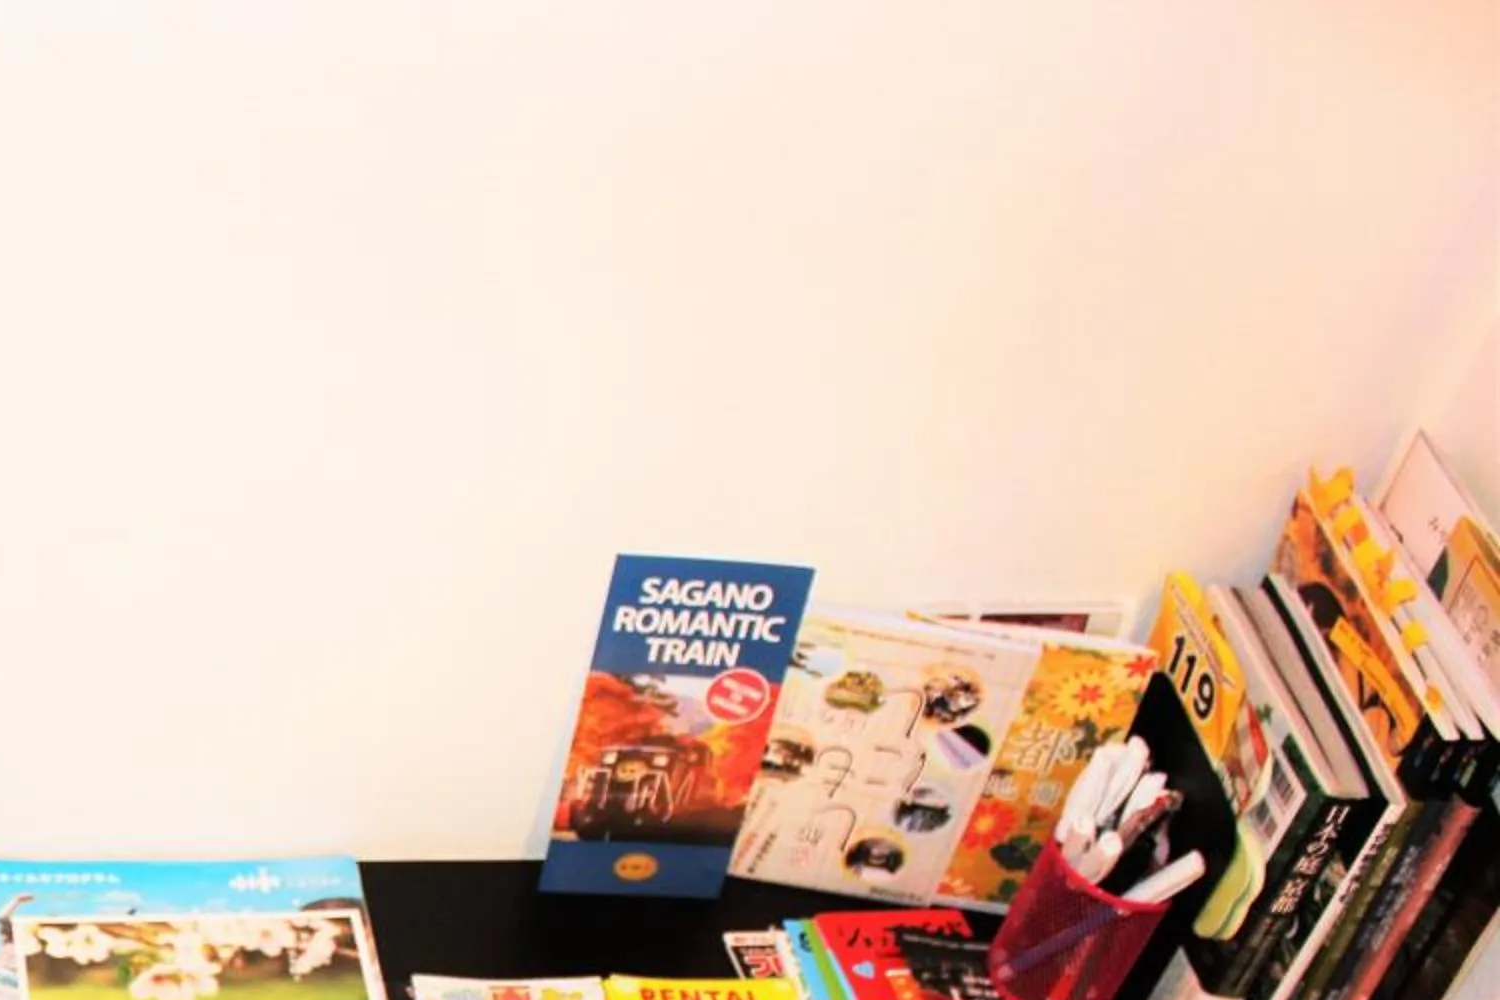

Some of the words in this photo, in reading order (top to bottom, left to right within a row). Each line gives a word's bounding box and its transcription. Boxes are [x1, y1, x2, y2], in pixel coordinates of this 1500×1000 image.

[638, 576, 774, 611] SAGANO
[612, 605, 787, 643] ROMANTIC
[645, 636, 741, 668] TRAIN
[1169, 636, 1215, 720] 119
